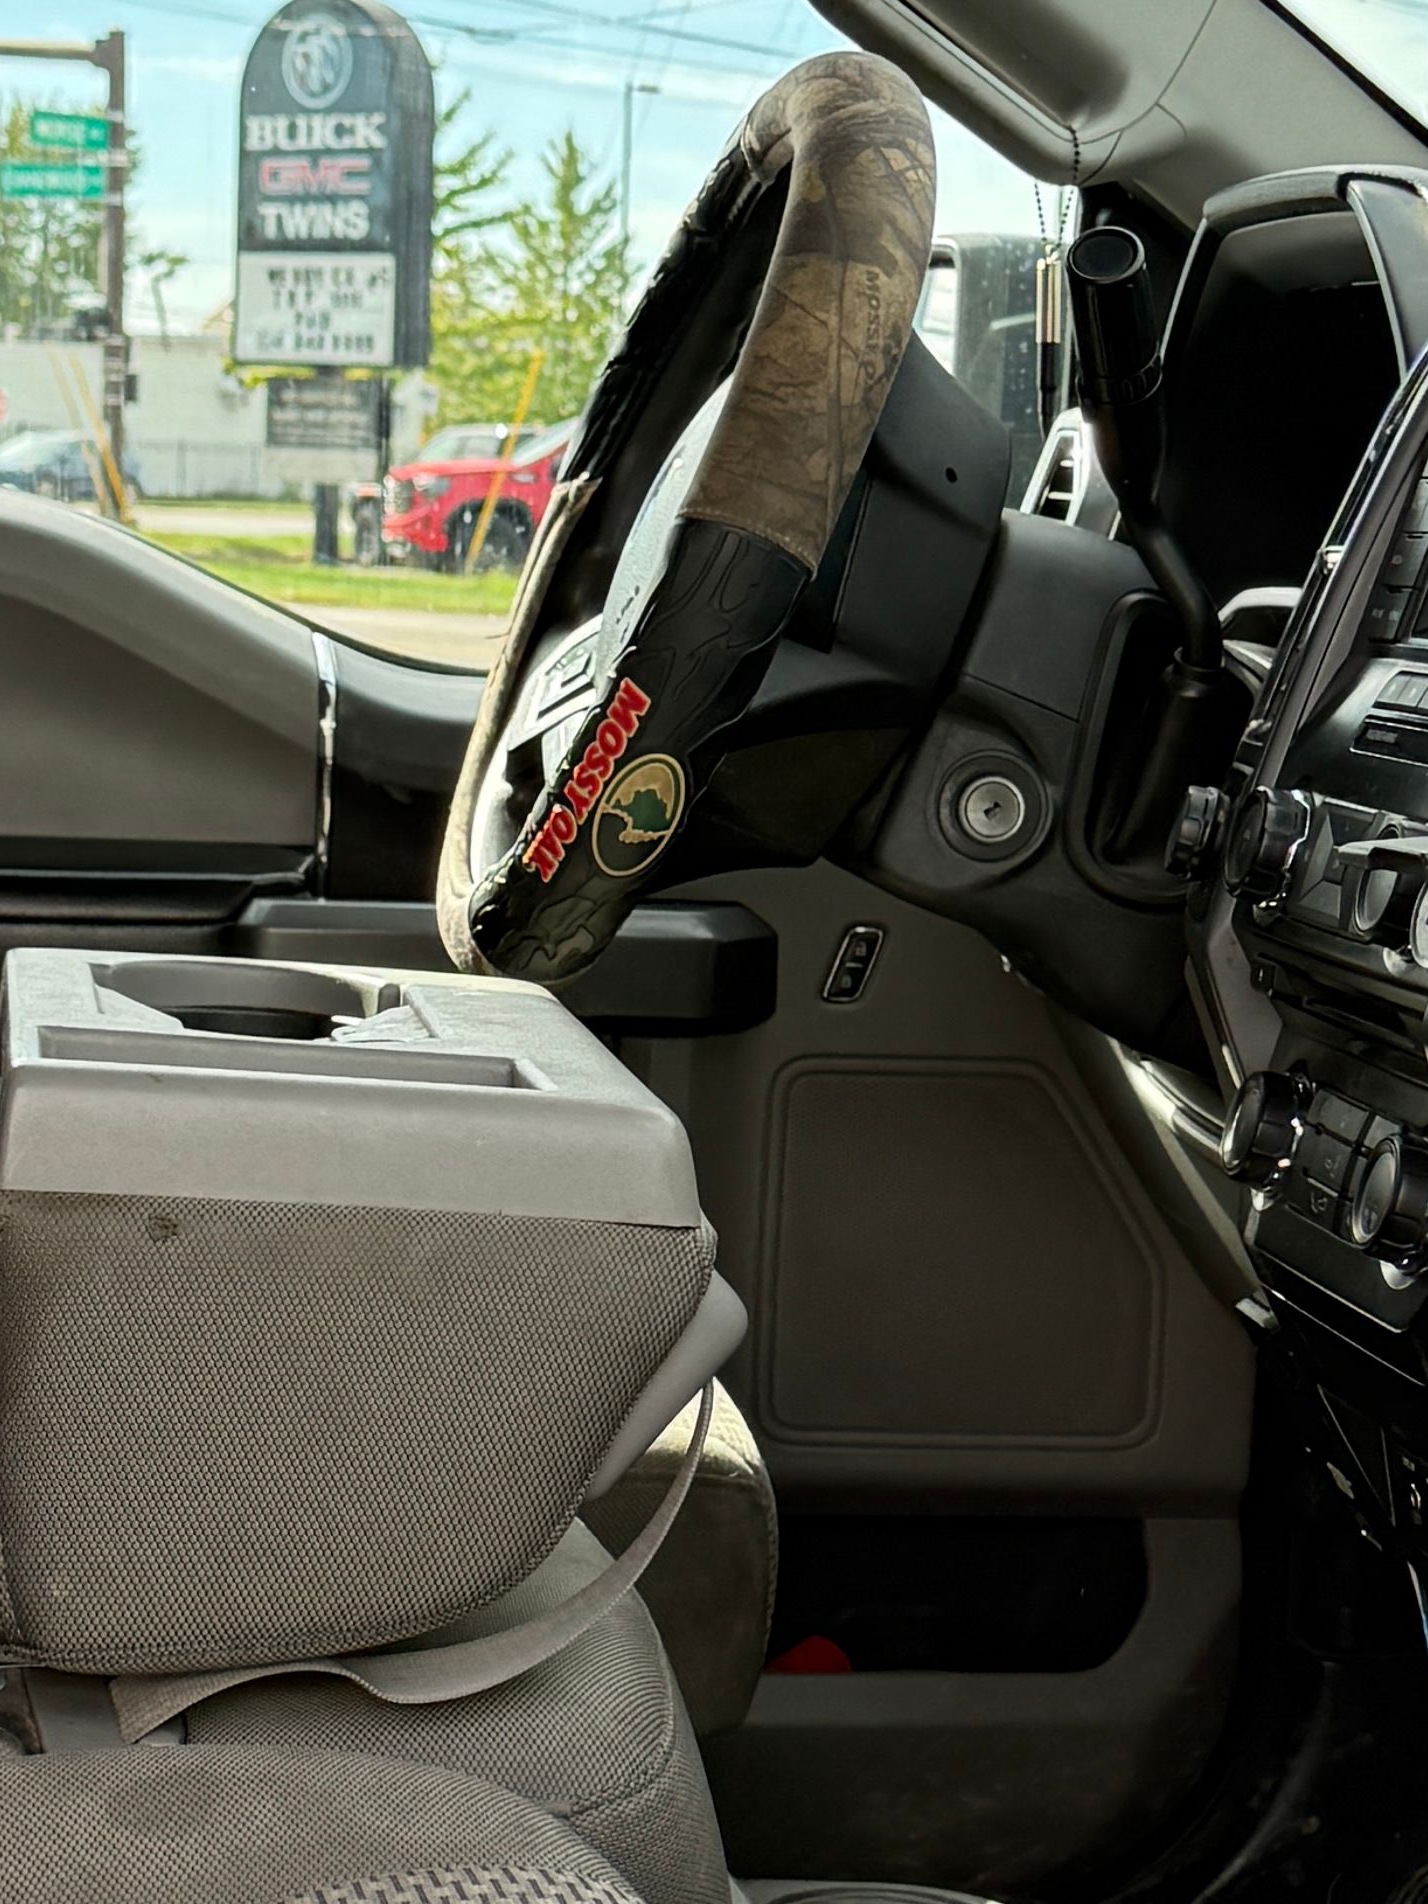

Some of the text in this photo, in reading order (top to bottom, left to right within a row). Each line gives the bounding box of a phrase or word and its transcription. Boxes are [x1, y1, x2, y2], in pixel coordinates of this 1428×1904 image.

[245, 112, 388, 152] BUICK
[259, 156, 371, 196] GMC
[257, 199, 370, 241] TWINS
[563, 676, 652, 825] MOSSY
